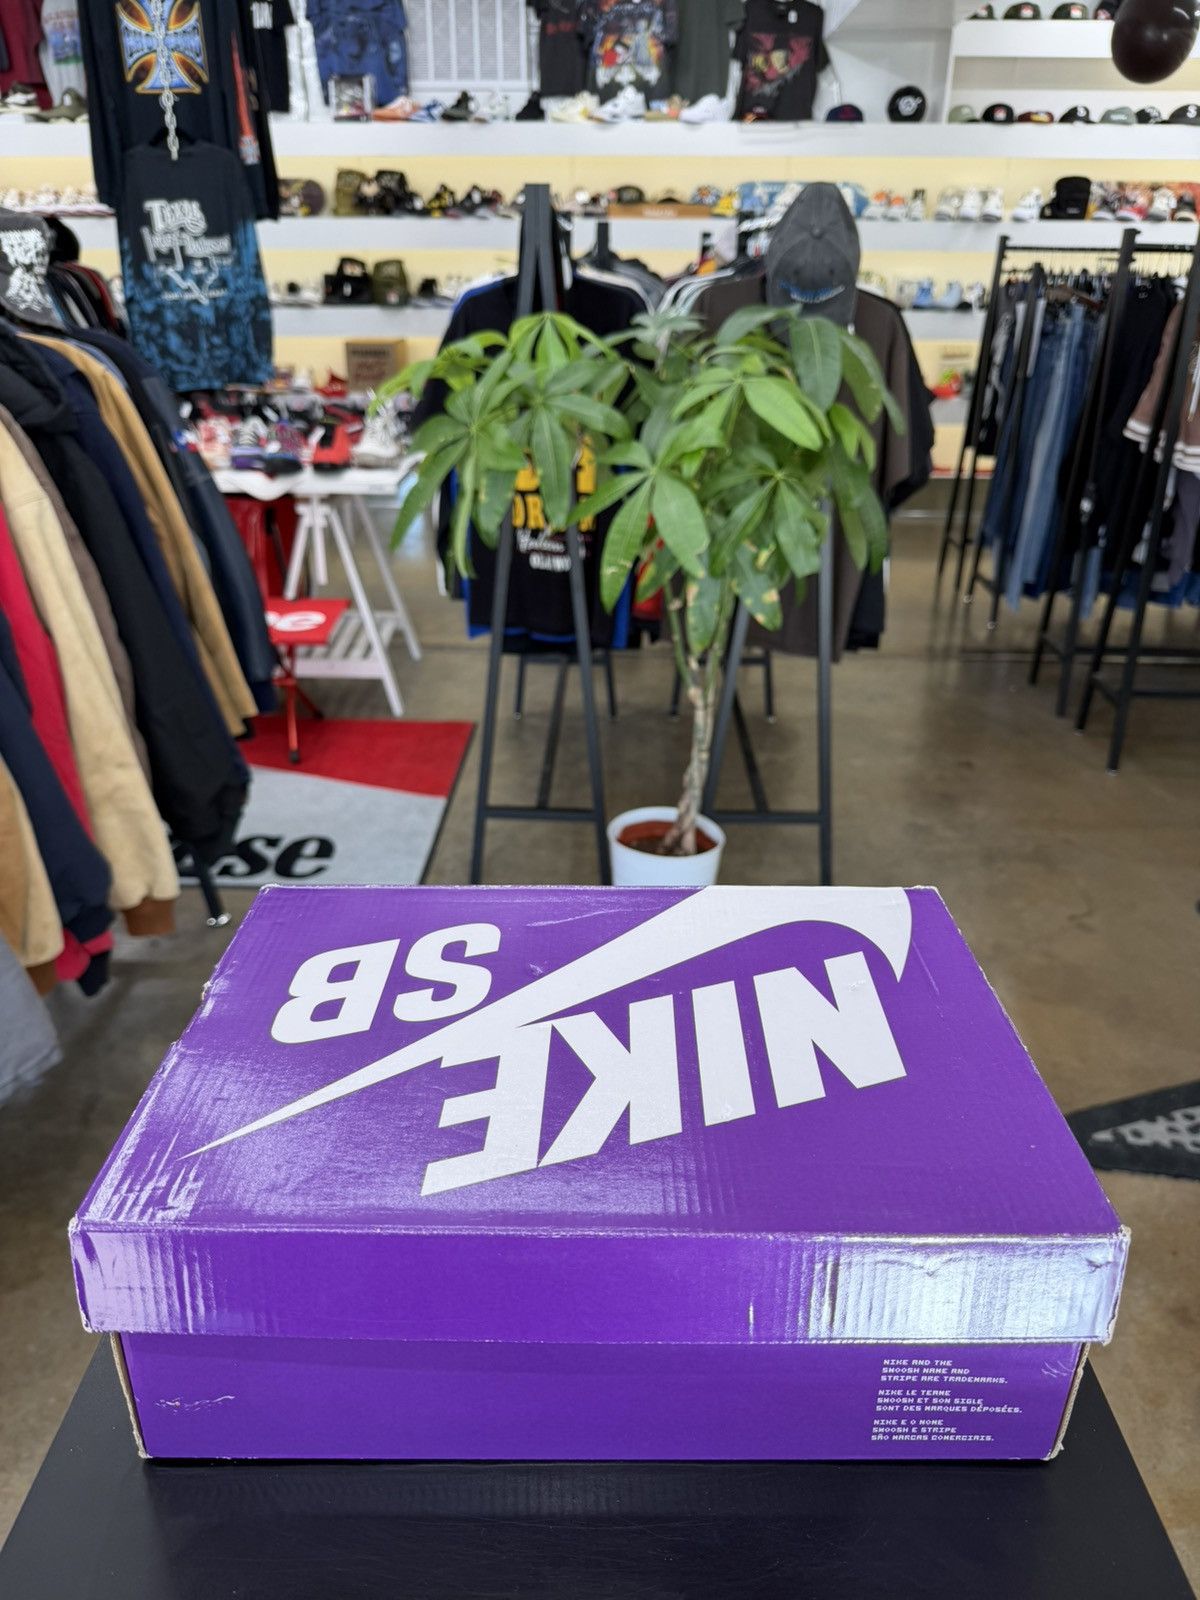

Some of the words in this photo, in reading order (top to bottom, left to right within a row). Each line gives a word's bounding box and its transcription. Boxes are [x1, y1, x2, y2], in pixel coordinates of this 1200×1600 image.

[270, 922, 502, 1044] SB
[420, 950, 907, 1197] NIKE
[934, 1359, 953, 1367] THE
[922, 1367, 948, 1375] NAME
[943, 1376, 1008, 1384] TRADEMARKS.
[921, 1389, 952, 1397] TERME
[970, 1404, 1023, 1413] DÉPOSÉES.
[872, 1426, 909, 1434] SWOOSH
[870, 1433, 890, 1441] SÃO
[931, 1434, 995, 1442] COMERCIAIS.
